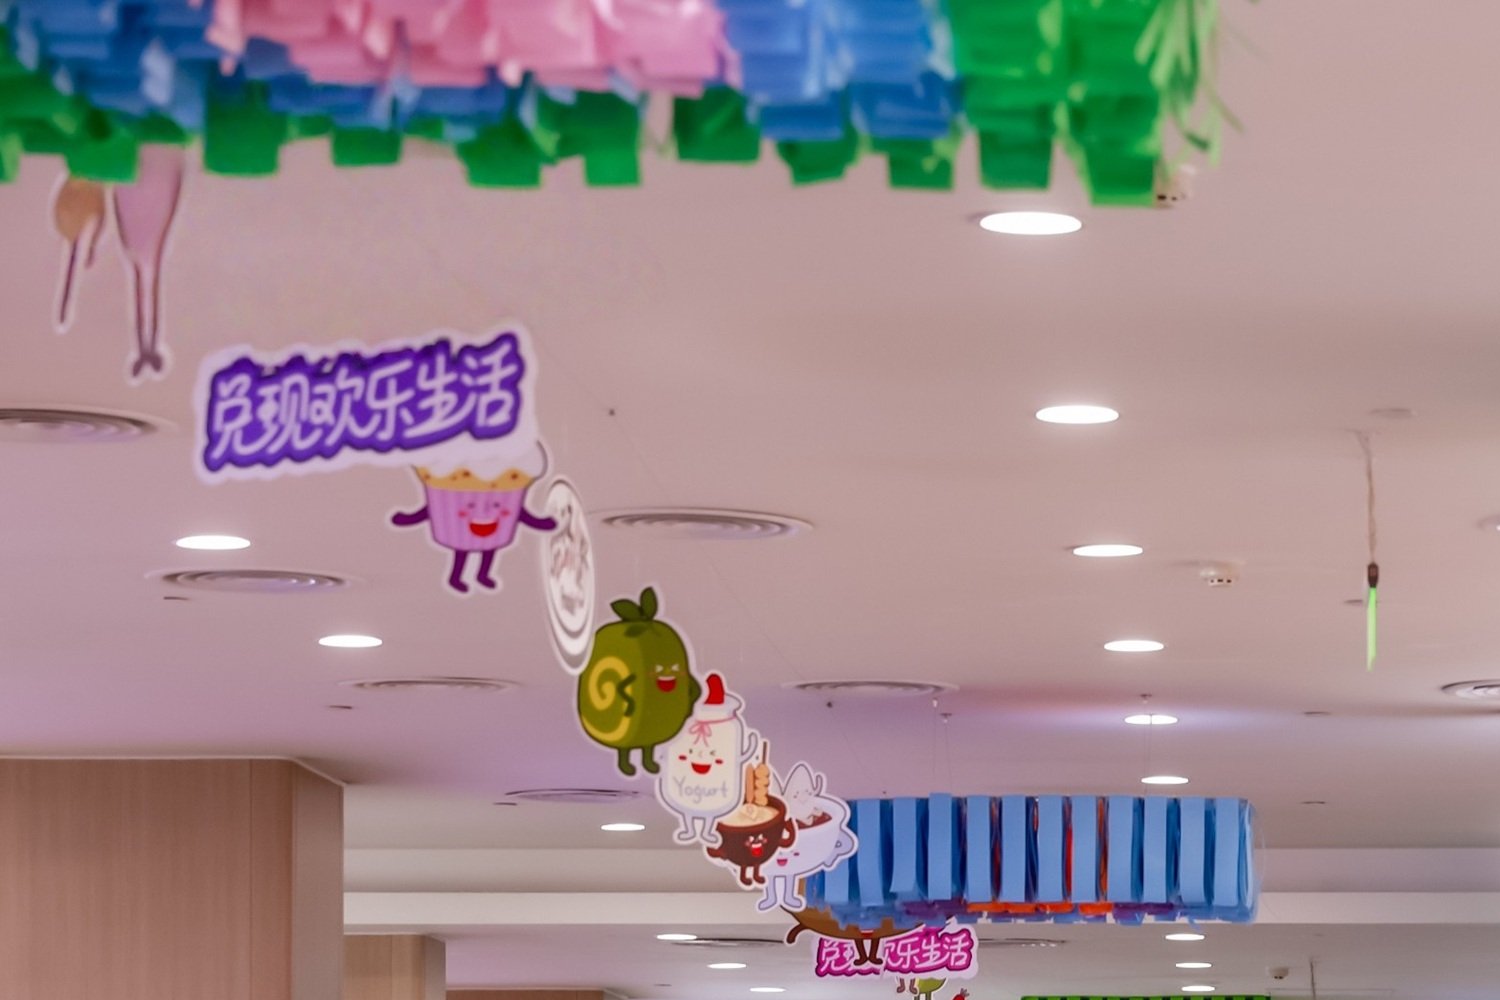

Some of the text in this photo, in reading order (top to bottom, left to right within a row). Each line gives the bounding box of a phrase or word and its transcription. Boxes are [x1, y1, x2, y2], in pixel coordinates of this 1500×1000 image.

[211, 343, 518, 461] 兑现欢乐生活
[672, 775, 729, 804] Yogurt
